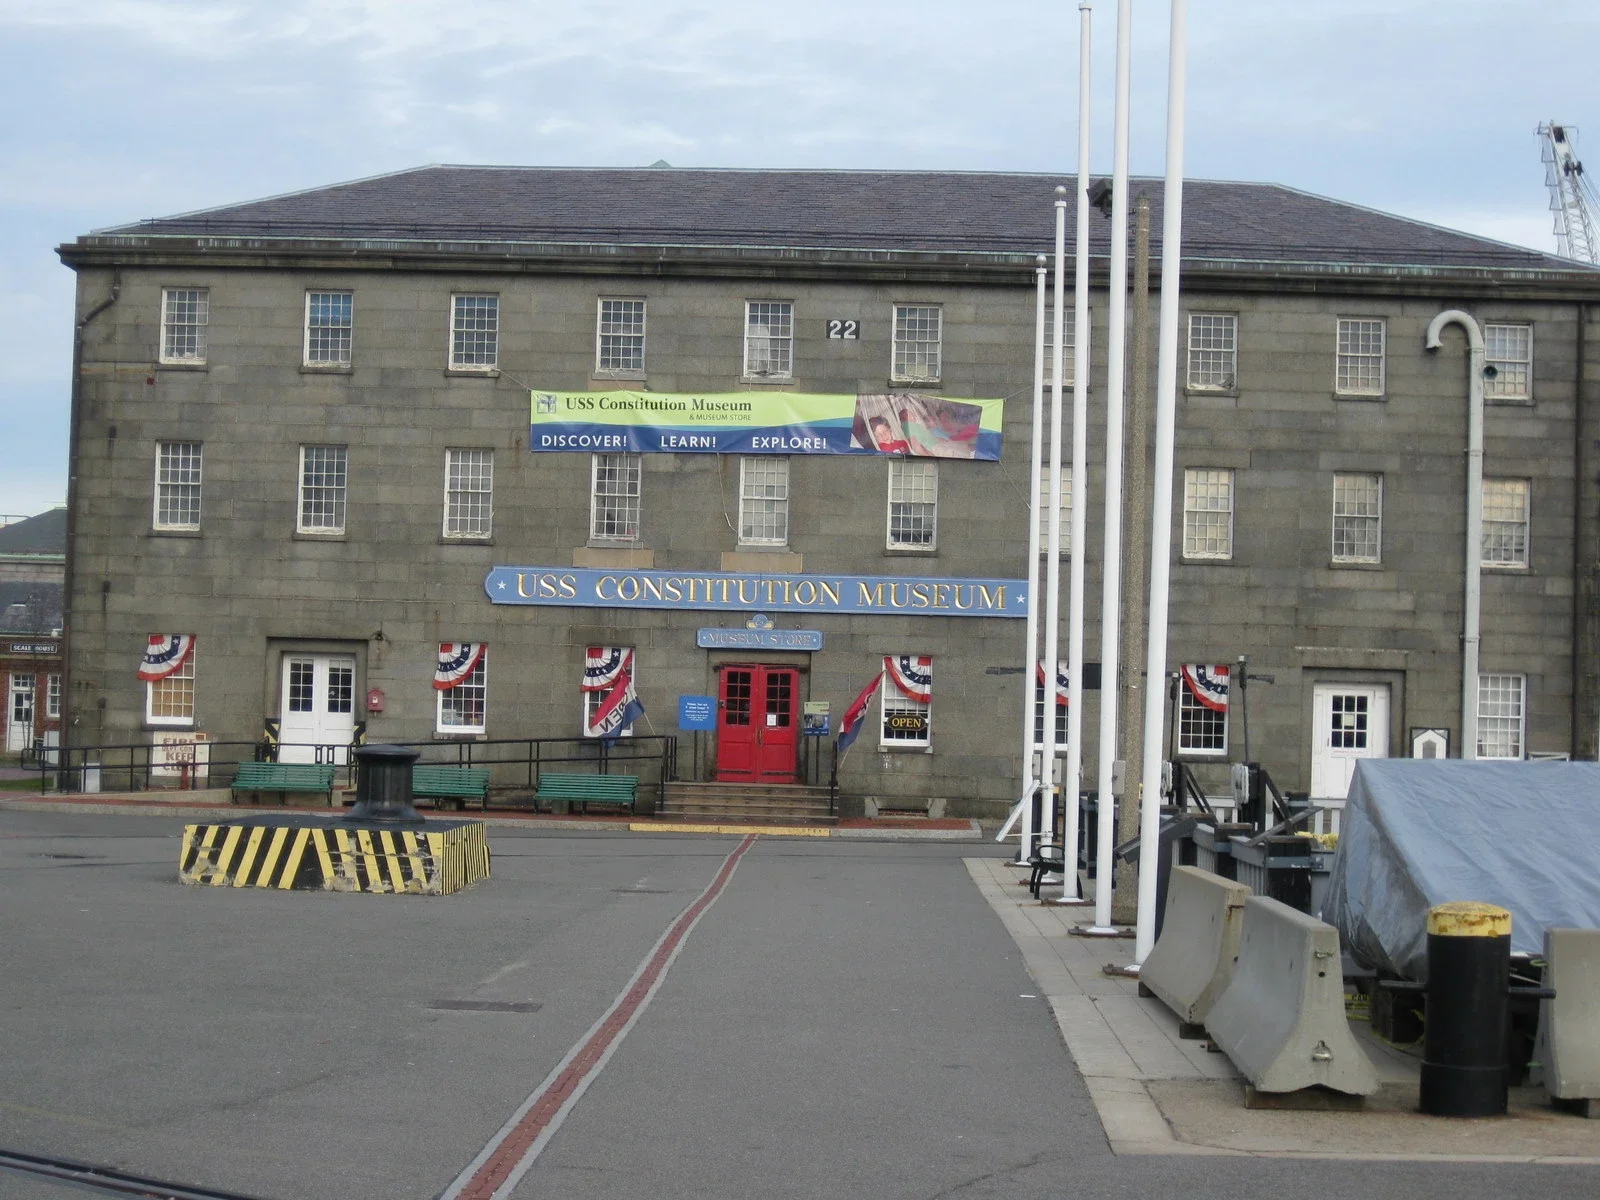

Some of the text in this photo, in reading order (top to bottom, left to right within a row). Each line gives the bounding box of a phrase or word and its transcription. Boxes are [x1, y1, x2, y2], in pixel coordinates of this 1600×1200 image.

[829, 319, 857, 339] 22
[565, 397, 752, 412] USS Constitution Museum
[729, 414, 752, 422] STORE
[541, 434, 827, 450] DISCOVER! LEARN! EXPLORE!
[516, 573, 1008, 610] USS CONSTITUTION MUSEUM
[708, 633, 811, 646] MUSEUM STORE
[891, 717, 922, 728] OPEN
[165, 752, 193, 761] KEEP
[163, 762, 199, 772] CLER
